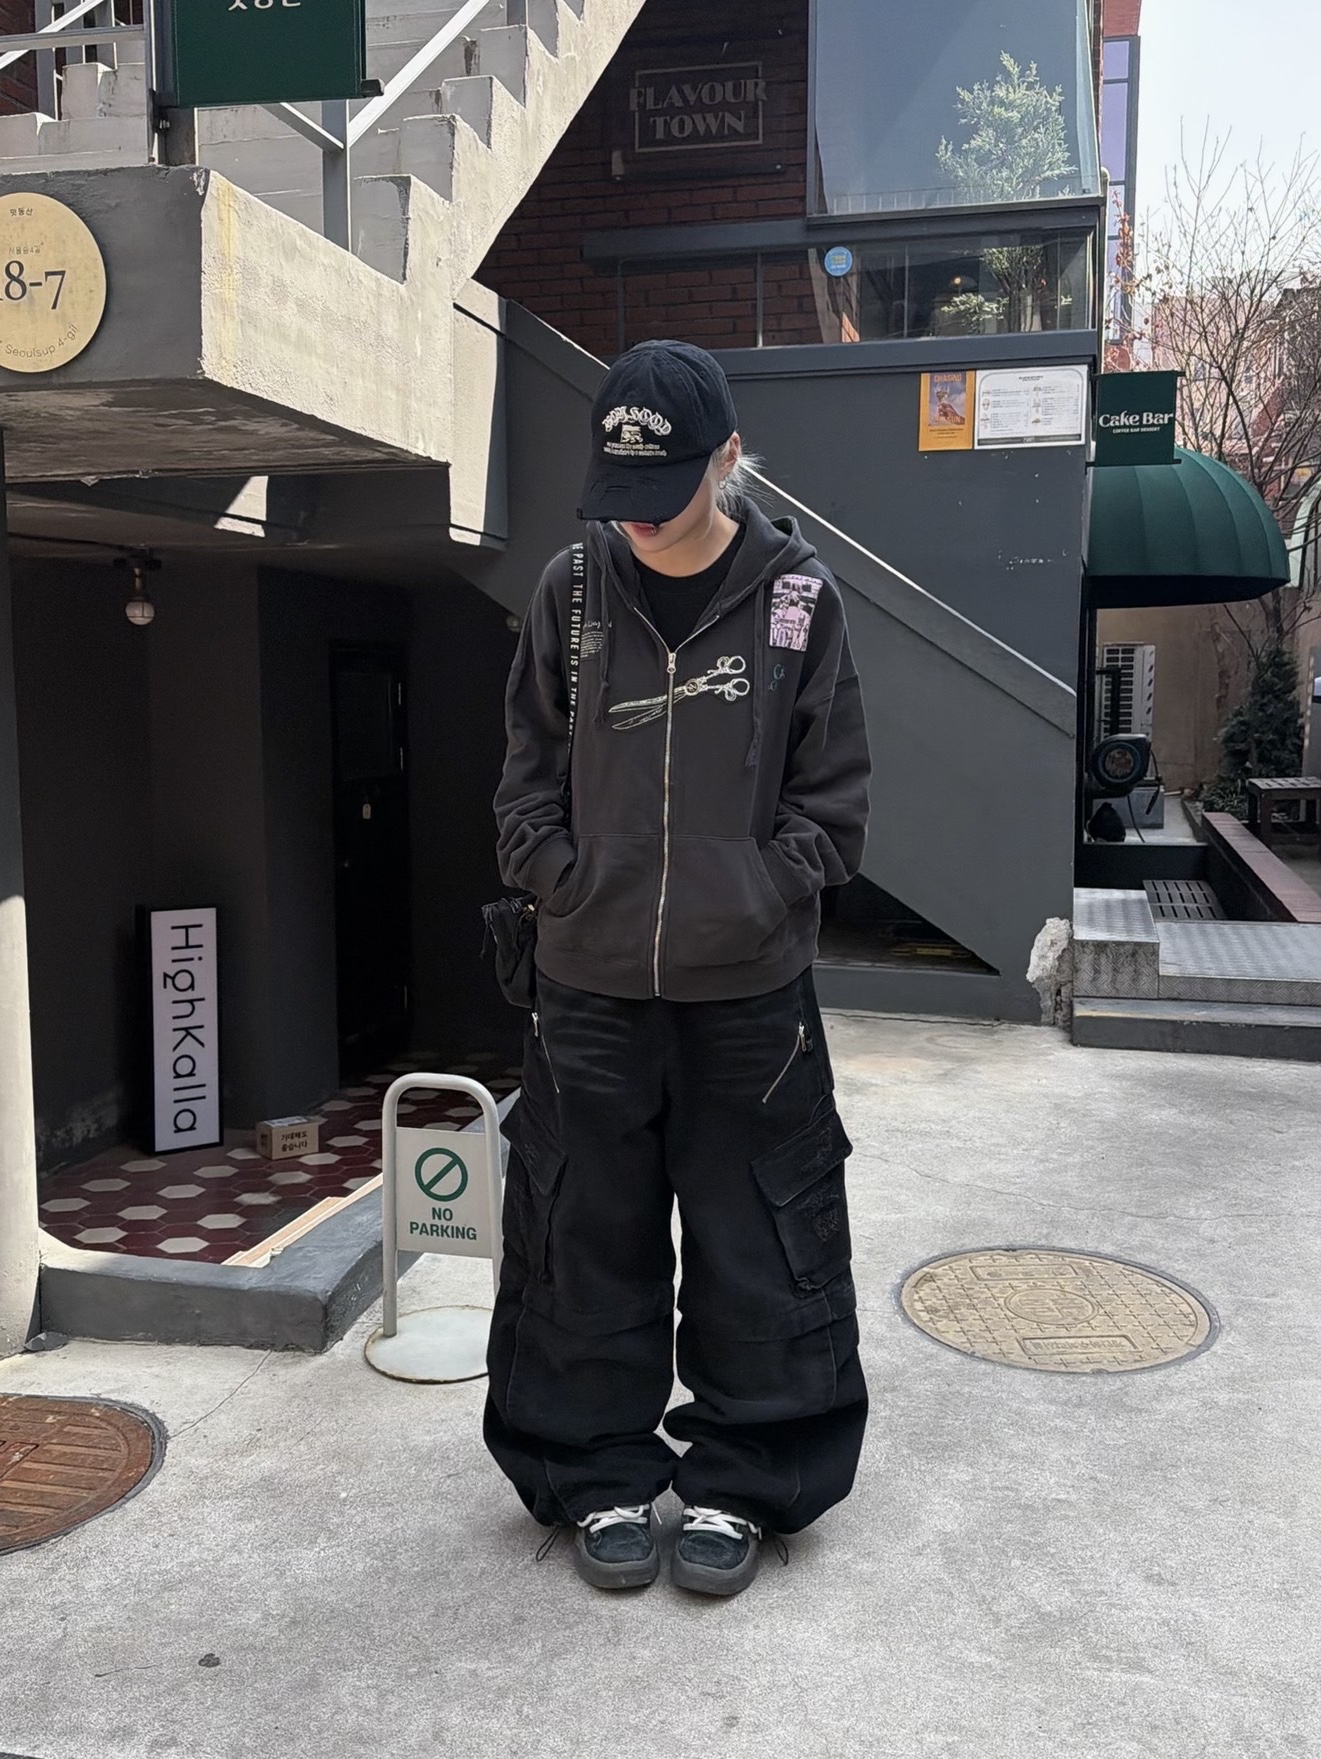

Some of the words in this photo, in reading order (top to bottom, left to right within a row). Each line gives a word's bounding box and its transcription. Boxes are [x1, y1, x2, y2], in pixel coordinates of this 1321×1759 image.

[629, 78, 768, 111] FLAVOUR
[650, 110, 746, 140] TOWN
[0, 259, 67, 311] 8-7
[4, 343, 56, 358] Seoulsup
[58, 323, 78, 347] 4-gil
[1098, 410, 1140, 428] Cake
[1142, 411, 1175, 425] Bar
[572, 553, 584, 577] PAST
[571, 584, 584, 604] THE
[570, 609, 582, 650] FUTURE
[570, 655, 579, 666] IS
[570, 671, 578, 683] IN
[162, 923, 206, 1134] HighKalla
[431, 1207, 454, 1221] NO
[409, 1221, 478, 1241] PARKING
